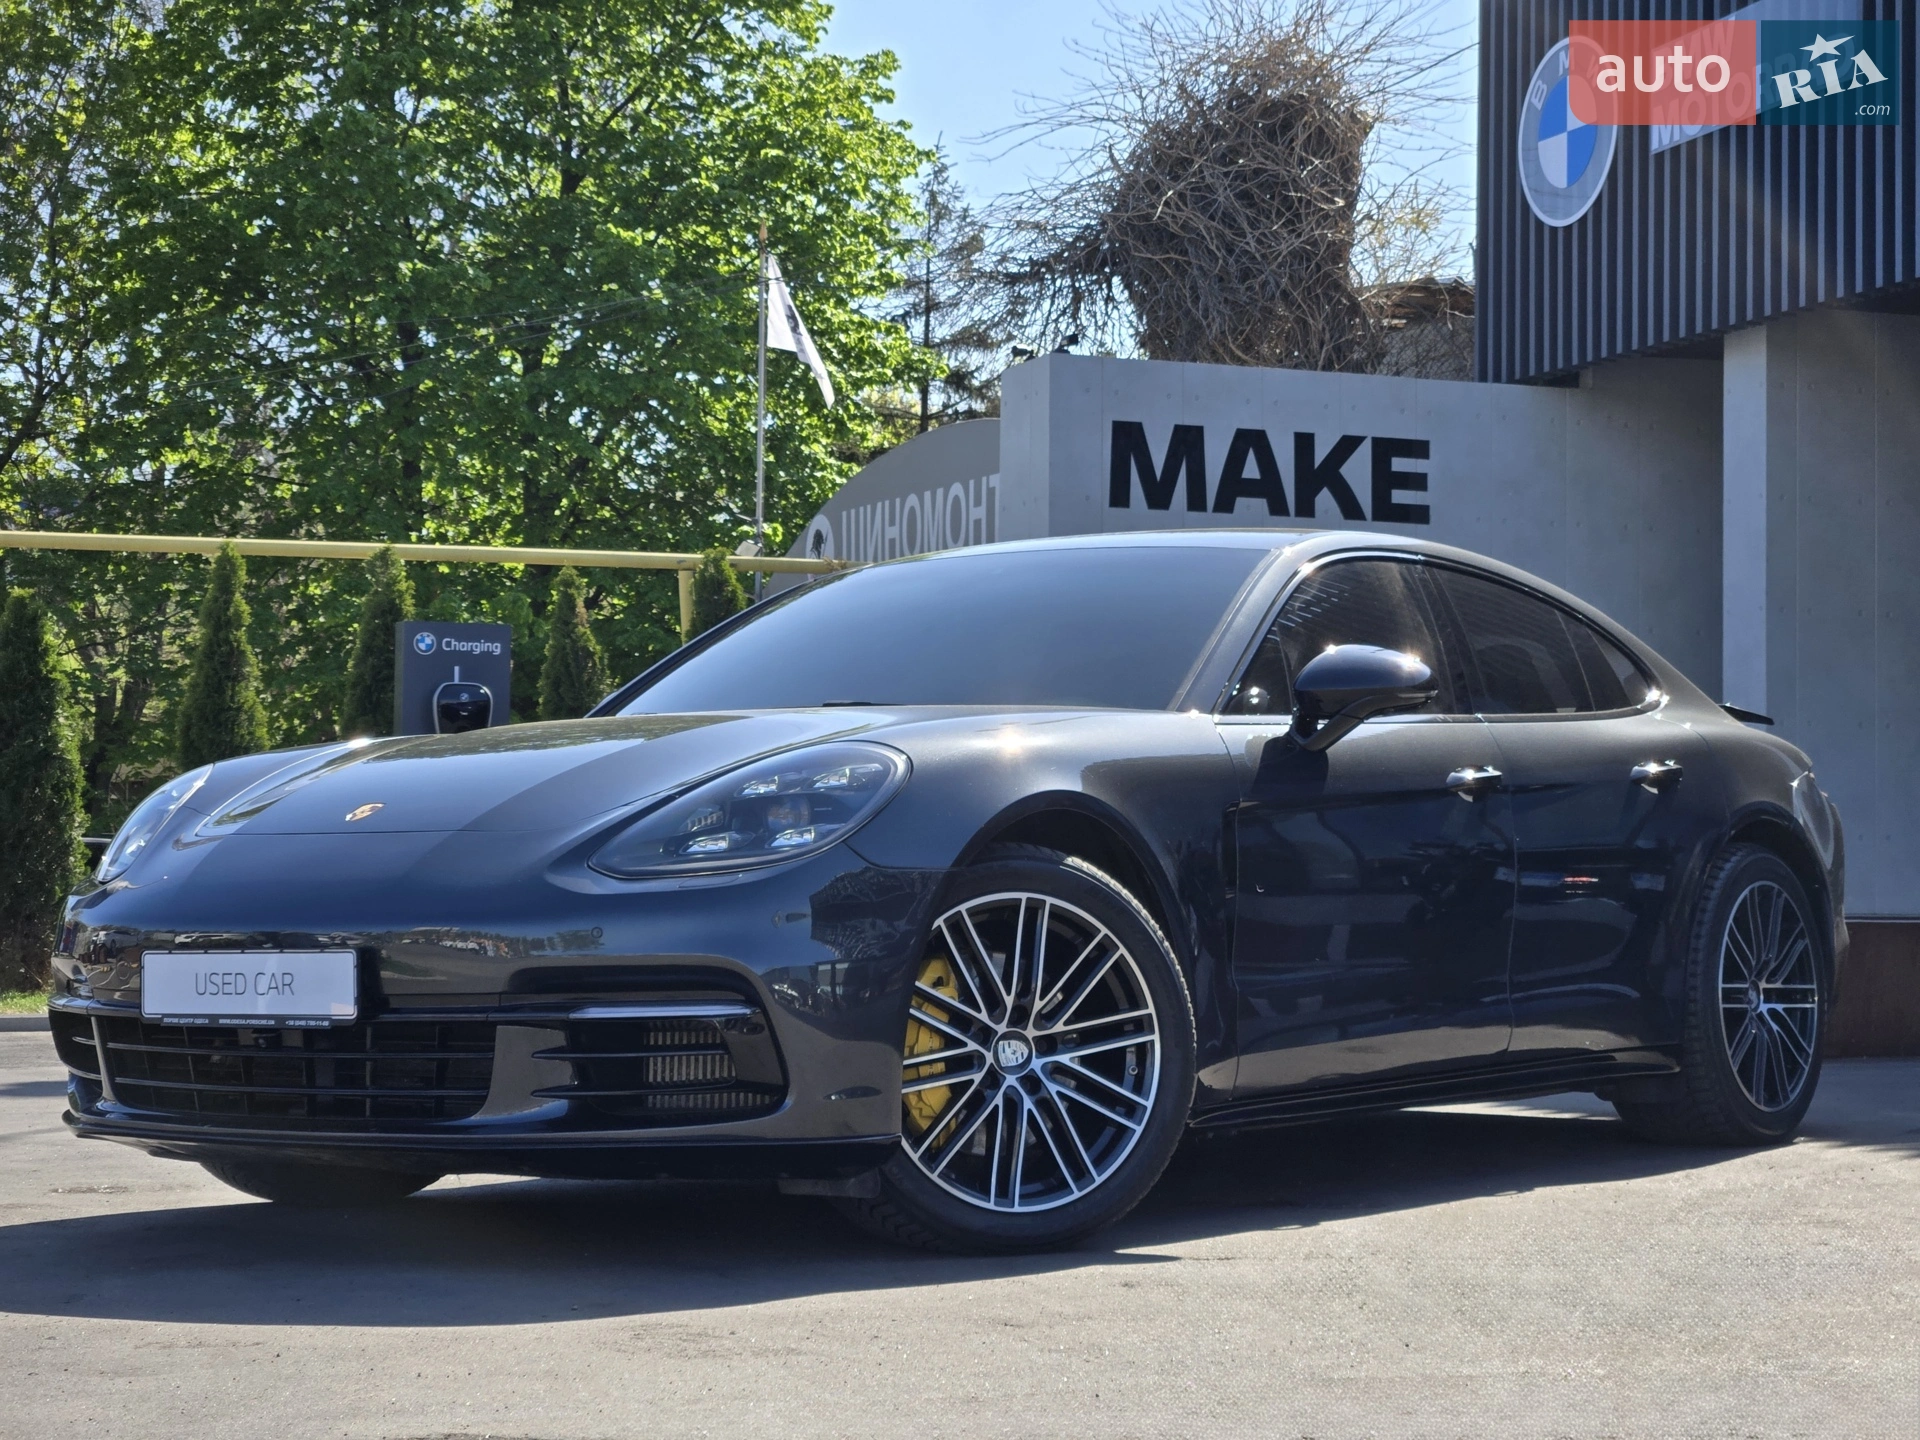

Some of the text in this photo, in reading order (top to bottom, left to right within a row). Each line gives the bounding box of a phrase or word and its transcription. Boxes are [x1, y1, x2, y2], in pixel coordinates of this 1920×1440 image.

[1108, 419, 1431, 525] MAKE
[441, 637, 502, 655] Charging
[194, 972, 296, 996] USED CAR
